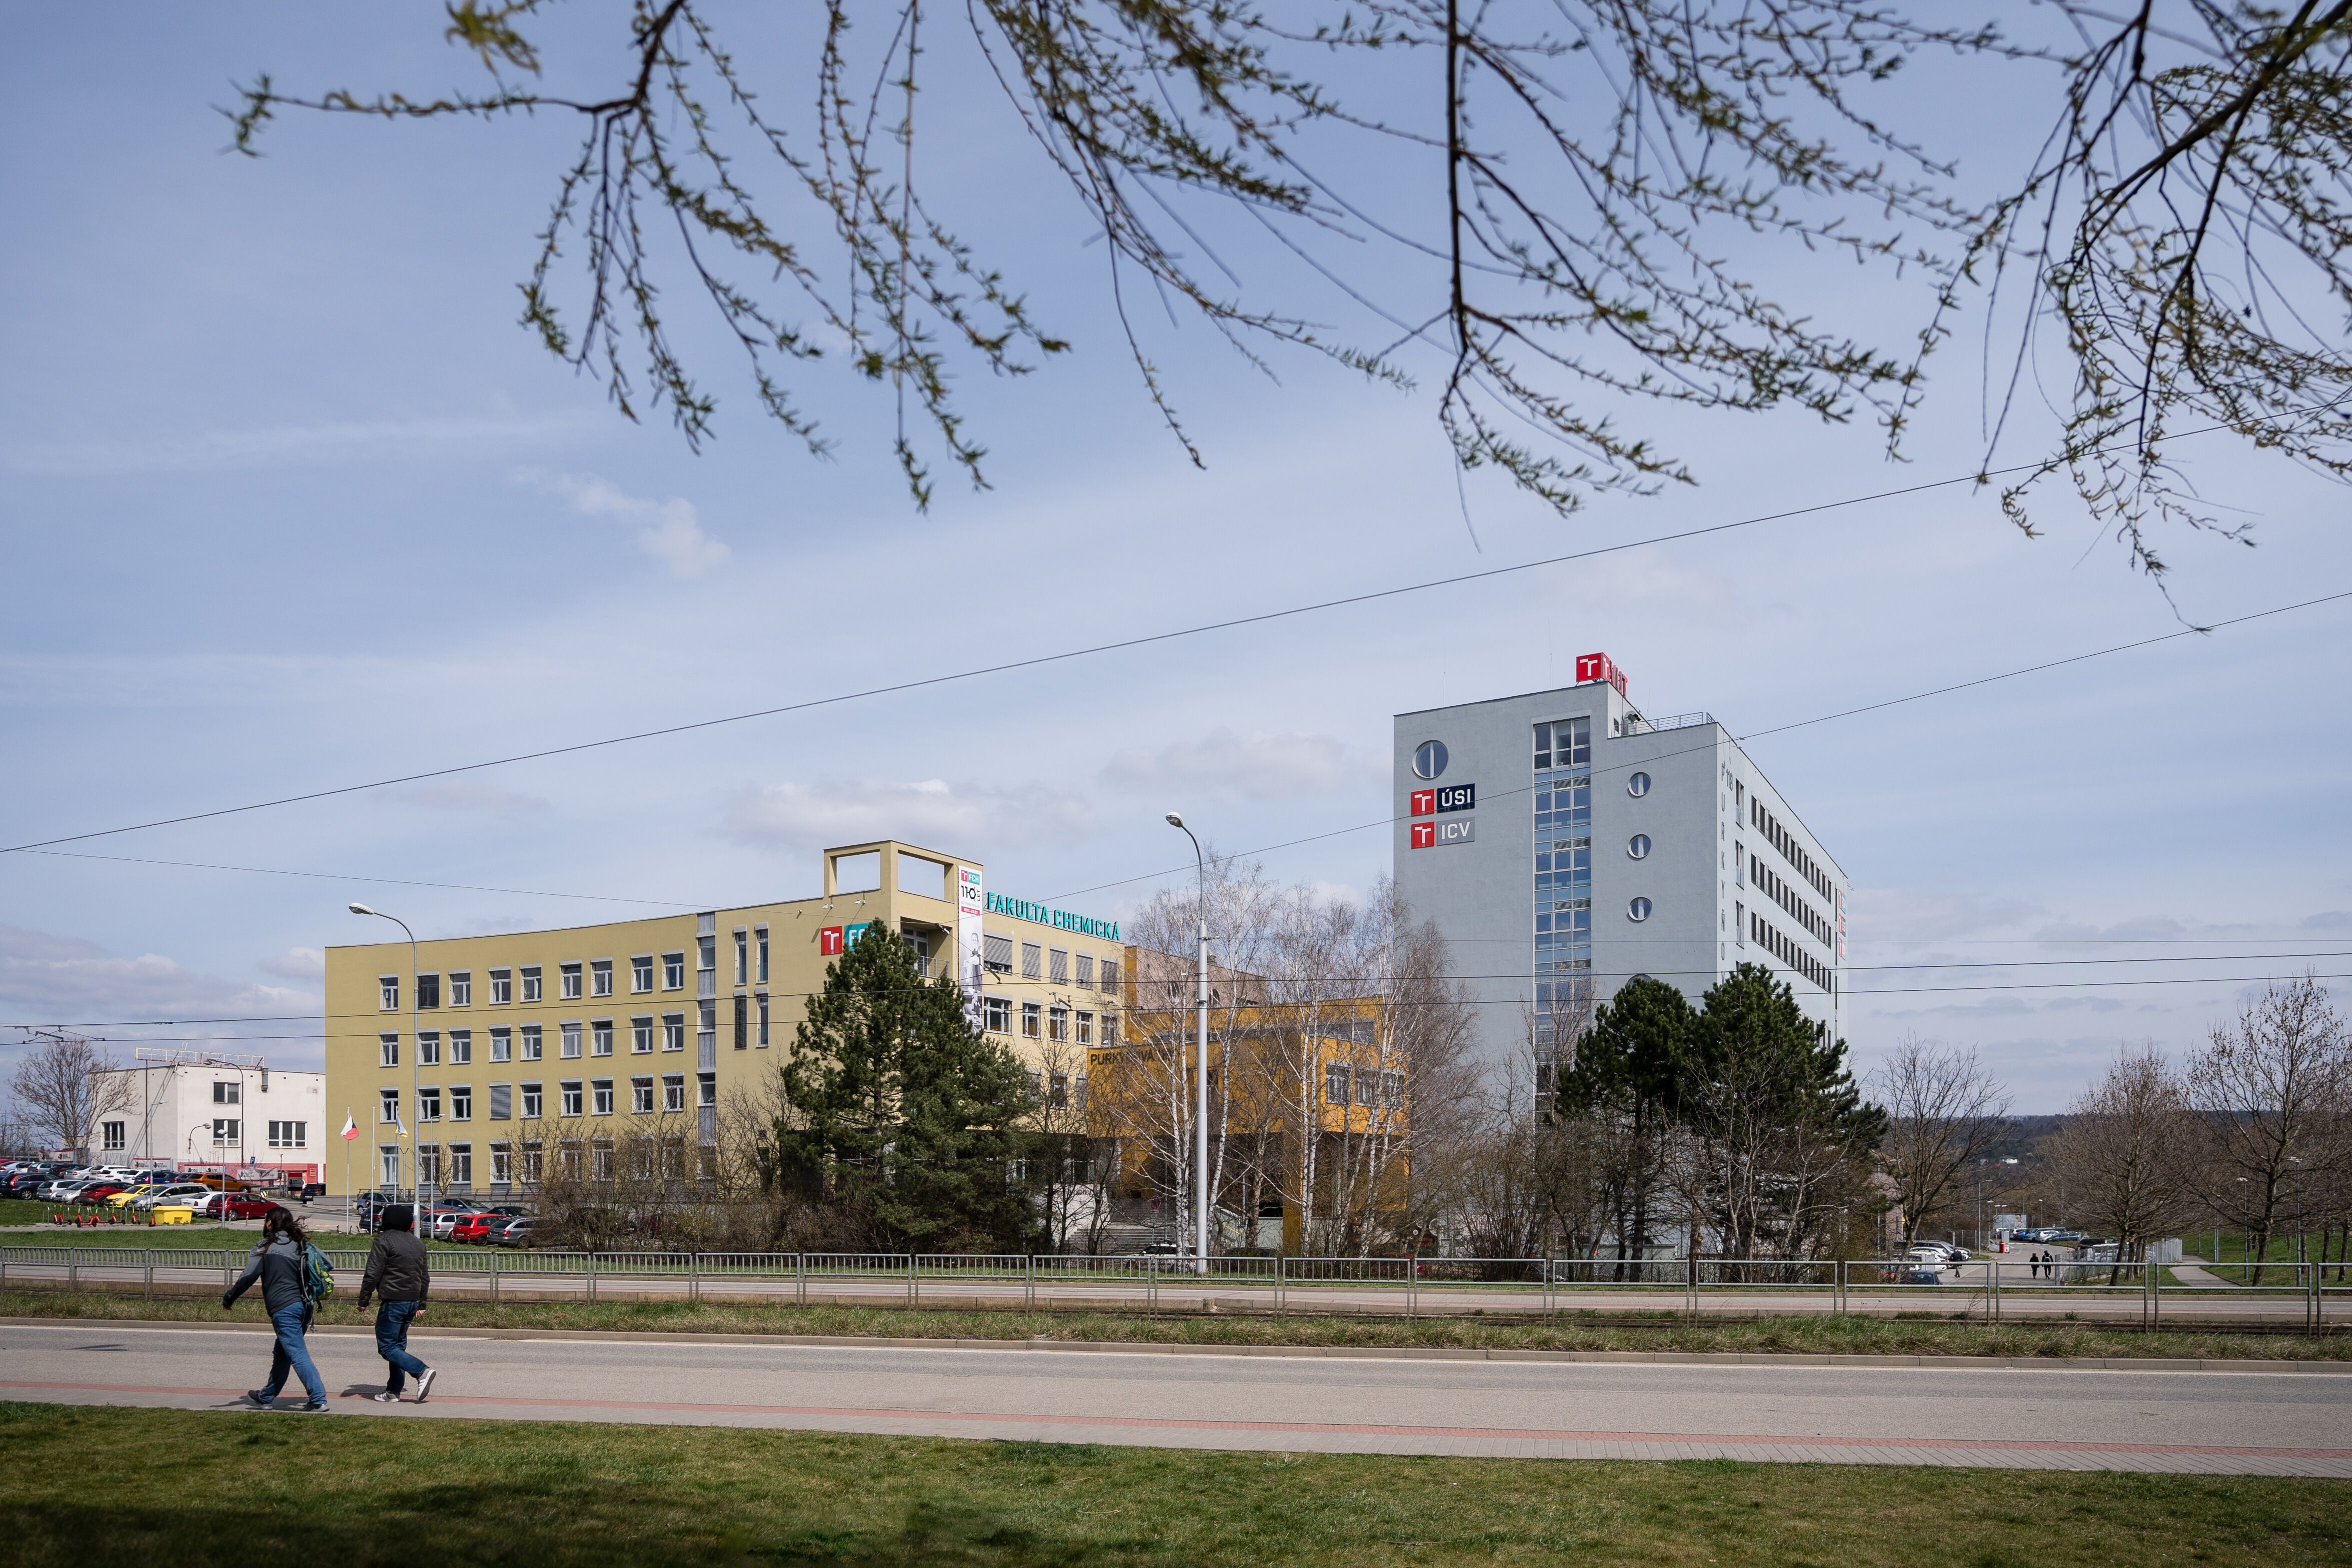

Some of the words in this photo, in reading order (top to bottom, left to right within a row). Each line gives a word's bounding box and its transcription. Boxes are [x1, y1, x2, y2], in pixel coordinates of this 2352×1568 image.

[1442, 788, 1470, 807] ÚSI
[1442, 822, 1470, 840] ICV
[969, 874, 979, 883] FCH
[987, 892, 1049, 924] FAKULTA
[1053, 909, 1120, 941] CHEMICKÁ
